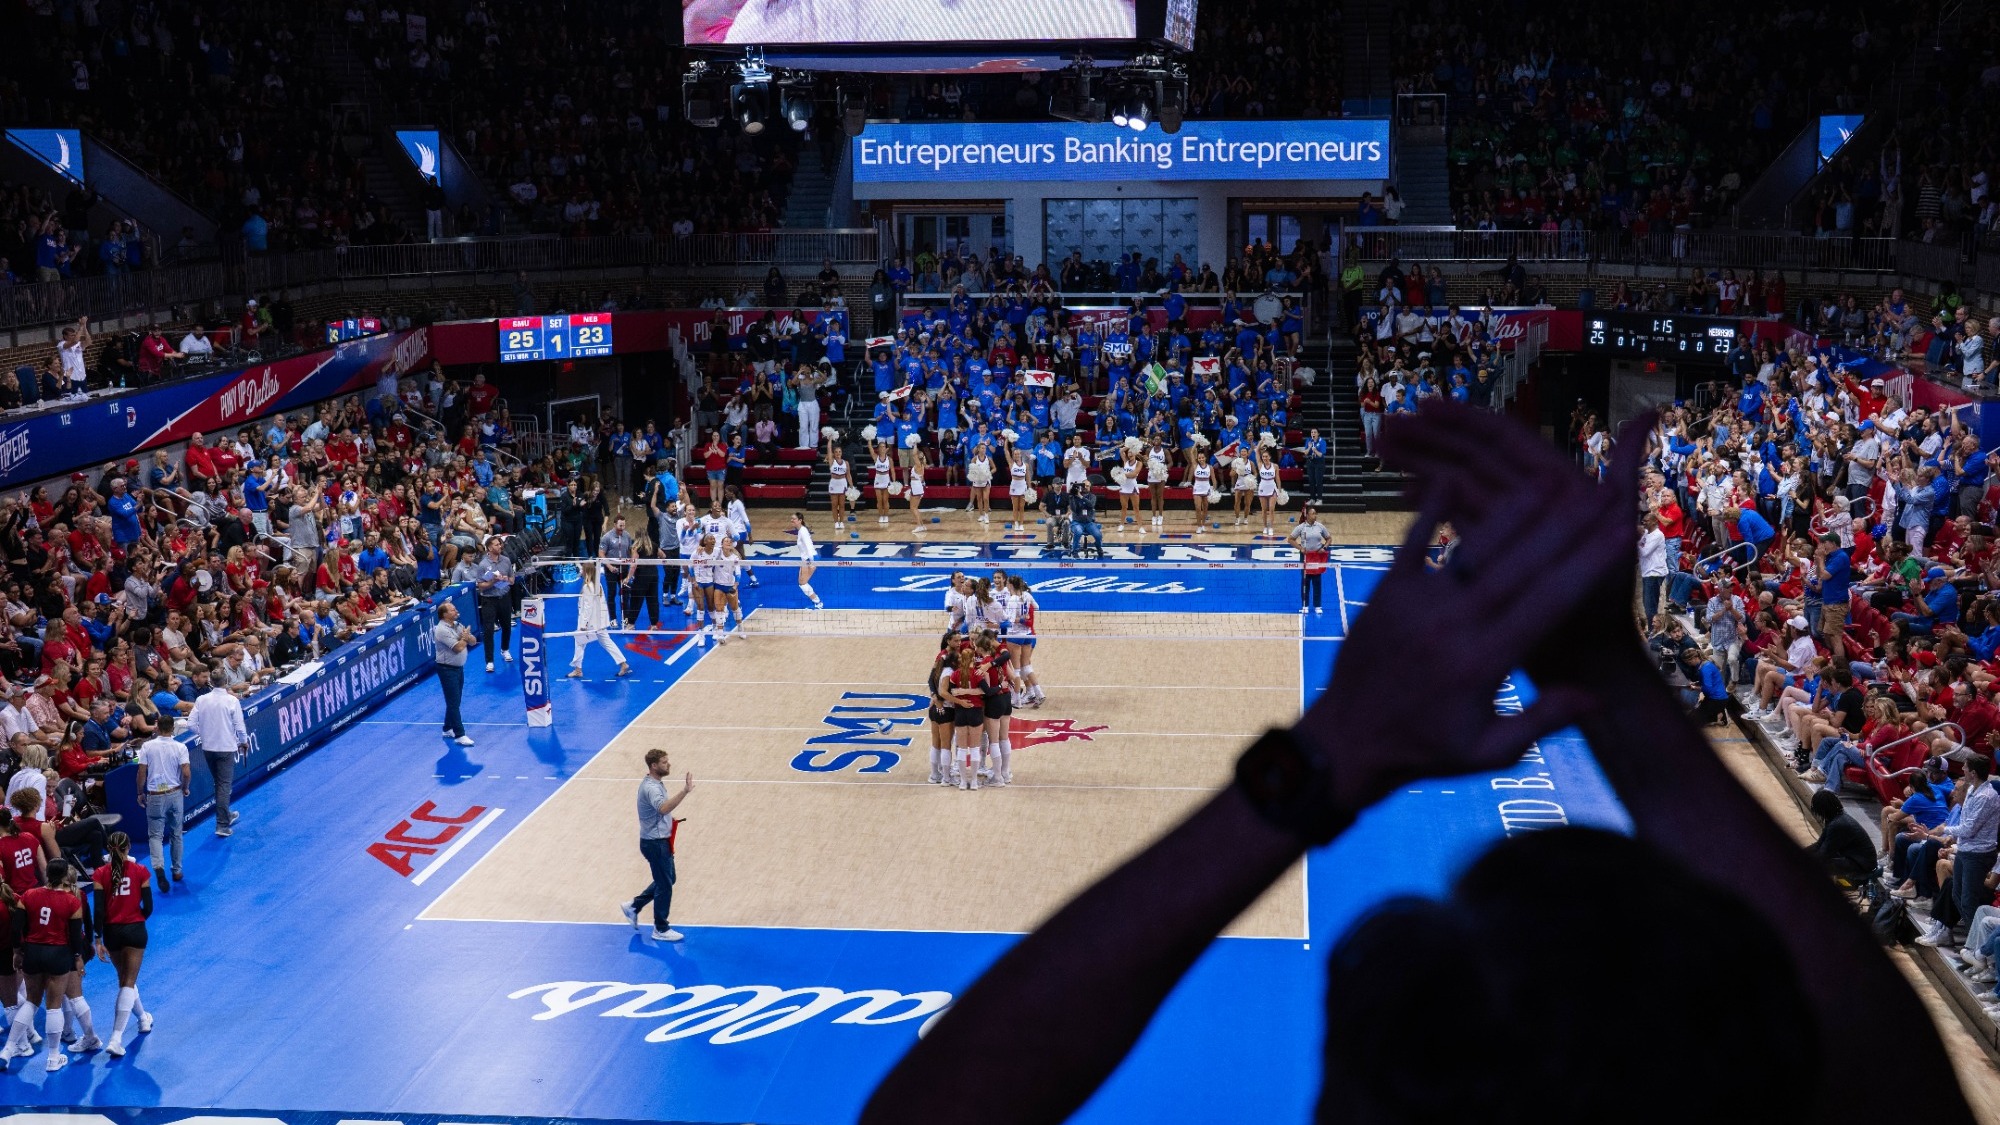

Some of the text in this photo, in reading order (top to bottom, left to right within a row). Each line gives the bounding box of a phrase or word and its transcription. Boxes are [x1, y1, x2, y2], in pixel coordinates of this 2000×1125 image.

[860, 136, 1381, 170] Entrepreneurs Banking Entrepreneurs
[512, 320, 530, 328] SMU
[549, 319, 562, 328] SET
[1366, 311, 1380, 320] 10
[728, 314, 743, 336] UP
[1653, 319, 1673, 334] 1:15
[1708, 327, 1735, 338] NEBRASKA
[508, 331, 534, 349] 25
[550, 335, 562, 352] 1
[579, 327, 604, 344] 23
[1590, 331, 1604, 344] 25
[1617, 336, 1623, 346] 0
[1103, 342, 1132, 353] SMU
[1679, 340, 1686, 351] 0
[1696, 341, 1703, 352] 0
[1714, 339, 1730, 353] 23
[220, 366, 280, 421] PONY UP Dallas
[109, 402, 119, 414] 113
[60, 413, 71, 426] 112
[872, 573, 1205, 595] Dllas
[522, 636, 543, 696] SMU
[278, 637, 406, 745] RHYTHM ENERGY
[789, 691, 932, 774] SMU
[365, 800, 488, 878] ACC
[14, 848, 33, 869] 22
[115, 877, 131, 896] 2
[39, 906, 52, 926] 9
[507, 980, 953, 1045] allas
